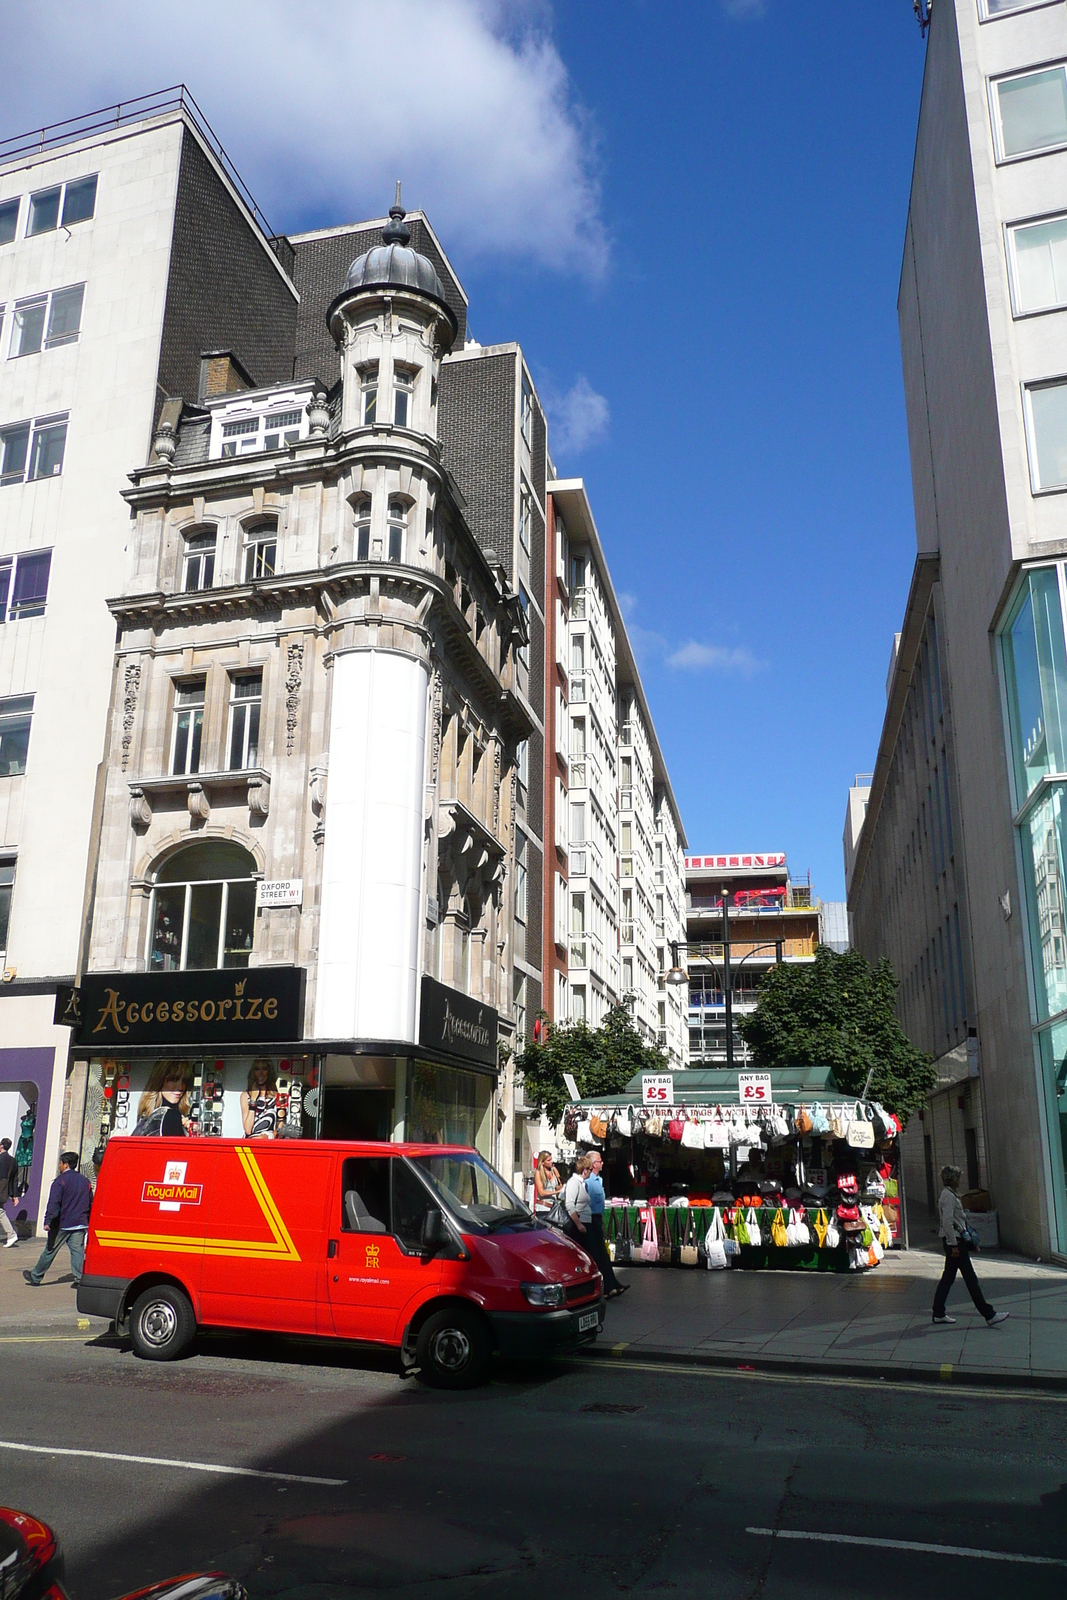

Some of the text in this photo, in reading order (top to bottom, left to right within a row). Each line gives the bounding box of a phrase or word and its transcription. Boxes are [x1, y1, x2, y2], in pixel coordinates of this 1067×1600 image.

[92, 979, 278, 1034] Accessorize
[647, 1087, 667, 1100] £5
[744, 1086, 765, 1099] £5
[147, 1185, 198, 1200] Royal Mail
[348, 1276, 390, 1285] www.royalmail.com
